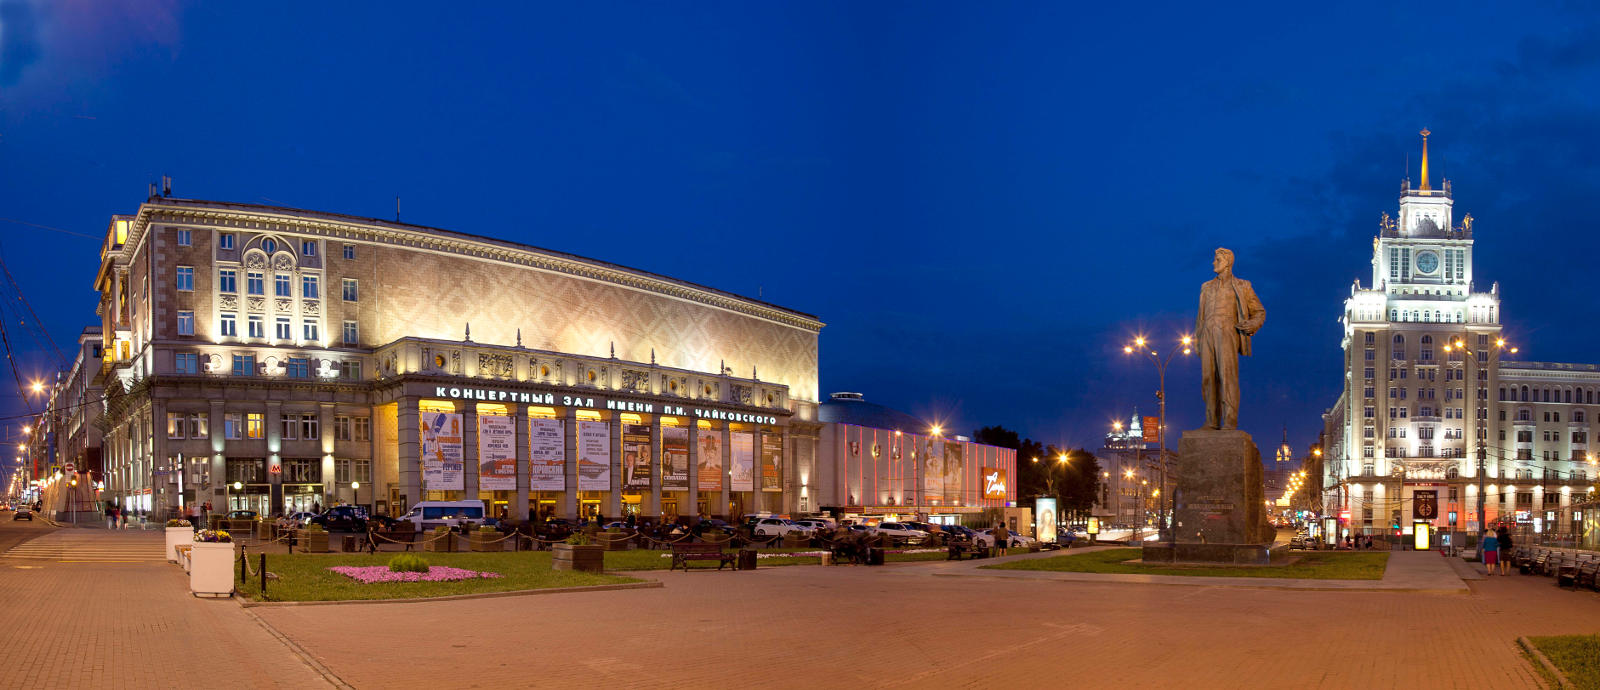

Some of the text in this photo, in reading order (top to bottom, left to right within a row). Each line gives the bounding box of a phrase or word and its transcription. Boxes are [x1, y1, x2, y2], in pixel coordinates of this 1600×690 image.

[436, 387, 776, 424] КОНЦЕРТНЫЙ ЗАЛ ИМЕНИ П.И. ЧАЙКОВСКОГО
